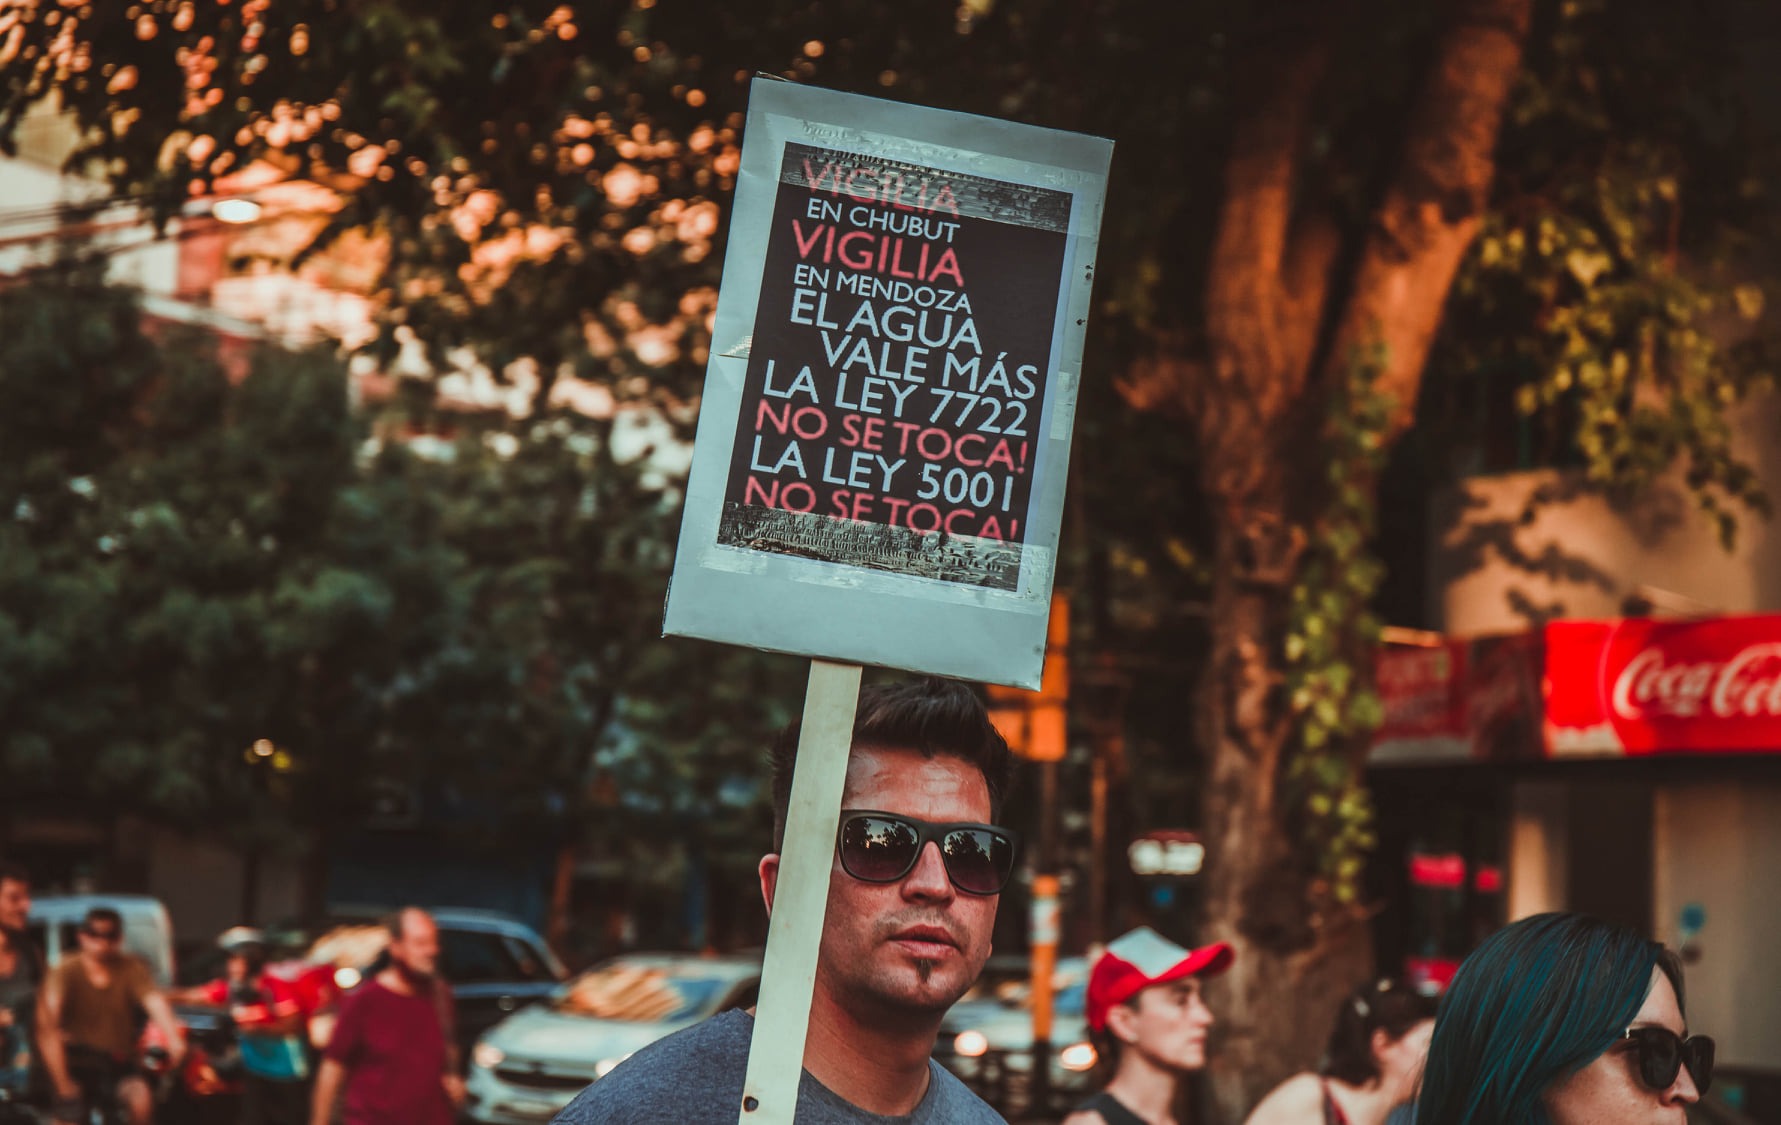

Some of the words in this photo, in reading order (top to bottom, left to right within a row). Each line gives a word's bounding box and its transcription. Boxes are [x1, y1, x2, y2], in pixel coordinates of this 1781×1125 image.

[803, 158, 960, 219] VIGILIA
[807, 197, 843, 223] EN
[849, 206, 961, 243] CHUBUT
[792, 218, 965, 288] VIGILIA
[790, 288, 839, 330] EL
[845, 300, 983, 355] AGUA
[793, 264, 830, 290] EN
[835, 271, 973, 315] MENDOZA
[763, 360, 820, 404] LA
[835, 372, 919, 418] LEY
[929, 387, 1028, 437] 7722
[820, 330, 930, 384] VALE
[941, 351, 1038, 400] MÁS
[755, 399, 829, 441] NO
[839, 414, 887, 452] SE
[892, 421, 1028, 474] TOCA!
[743, 475, 817, 516] NO
[827, 489, 875, 527] SE
[750, 434, 807, 479] LA
[822, 447, 907, 493] LEY
[916, 463, 1014, 512] 5001
